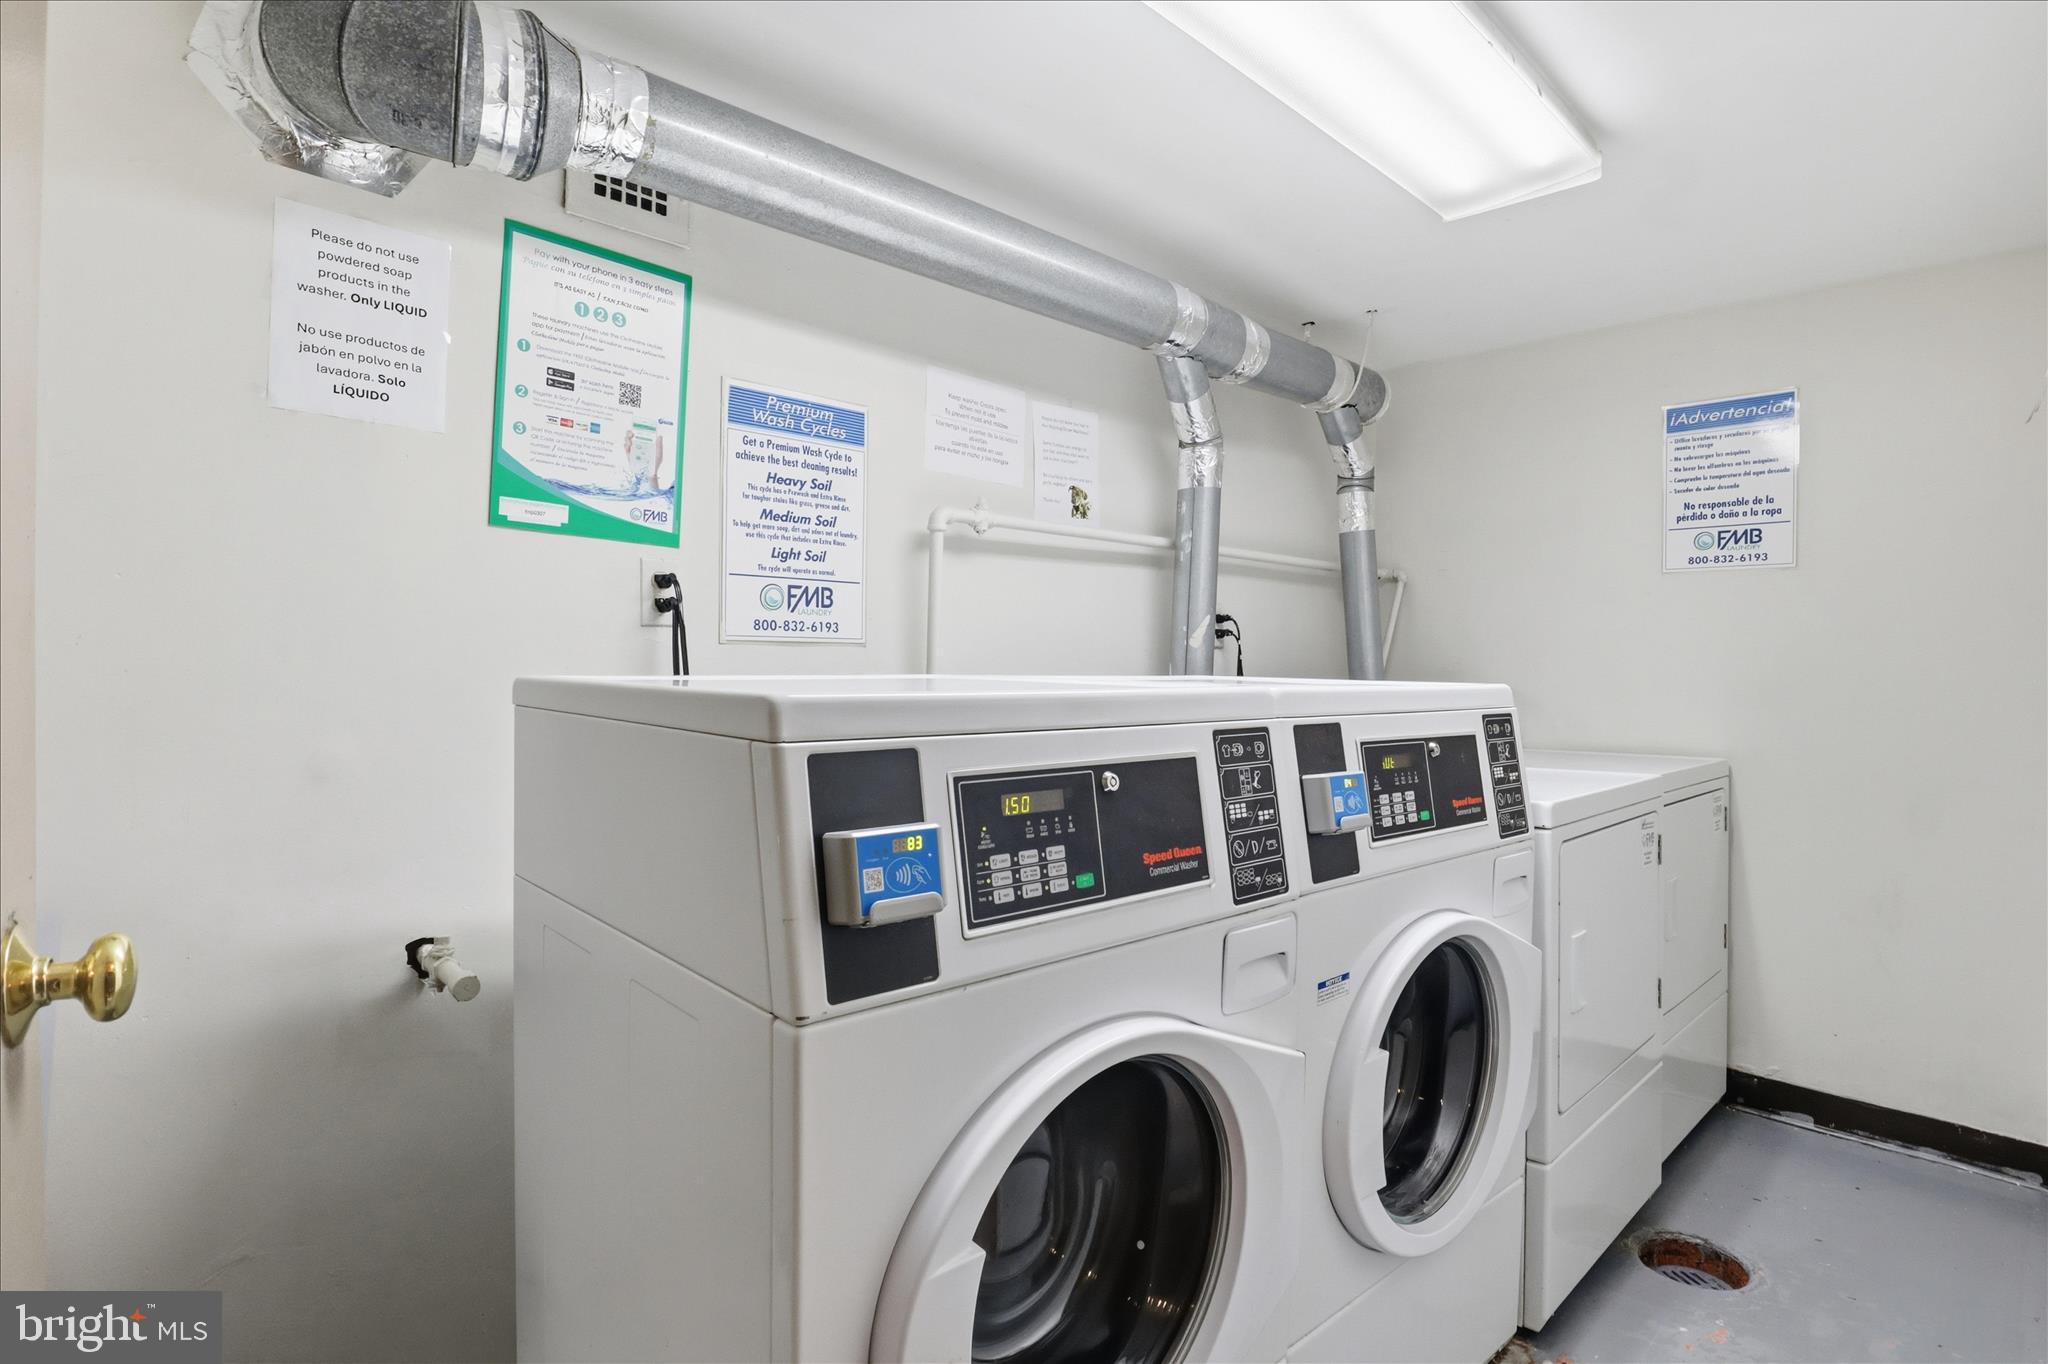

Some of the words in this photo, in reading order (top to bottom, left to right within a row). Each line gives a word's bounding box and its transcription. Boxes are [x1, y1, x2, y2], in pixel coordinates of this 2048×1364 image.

[312, 228, 353, 247] Please
[357, 241, 372, 252] do
[376, 247, 394, 258] not
[398, 252, 419, 264] use
[318, 250, 380, 272] powdered
[384, 265, 412, 280] soap
[534, 248, 551, 259] Pay
[553, 254, 570, 265] with
[572, 259, 589, 272] your
[592, 265, 618, 279] phone
[620, 273, 626, 281] in
[635, 279, 652, 290] easy
[655, 283, 674, 296] steps
[551, 265, 565, 273] con
[318, 269, 374, 289] products
[378, 281, 388, 291] in
[392, 285, 410, 296] the
[573, 286, 585, 295] EASY
[297, 282, 346, 301] washer.
[351, 293, 380, 309] Only
[384, 300, 427, 318] LIQUID
[297, 323, 315, 334] No
[319, 329, 342, 339] use
[346, 333, 408, 353] productos
[411, 346, 425, 356] de
[299, 342, 335, 356] jabón
[339, 350, 354, 360] en
[358, 353, 391, 367] polvo
[394, 360, 409, 370] en
[412, 363, 422, 373] la
[317, 363, 374, 382] lavadora.
[378, 374, 406, 387] Solo
[333, 384, 390, 401] LÍQUIDO
[766, 396, 834, 421] Premium
[752, 408, 794, 428] Wash
[801, 418, 847, 439] Cycles
[743, 435, 756, 446] Get
[767, 439, 800, 454] Premium
[803, 445, 822, 457] Wash
[825, 450, 842, 462] Cycle
[845, 454, 852, 462] to
[736, 450, 765, 463] achieve
[768, 454, 780, 464] the
[782, 456, 798, 468] best
[801, 460, 829, 475] cleaning
[832, 467, 858, 477] results!
[748, 483, 758, 491] This
[766, 472, 806, 490] Heavy
[810, 478, 832, 491] Soil
[1684, 502, 1695, 512] No
[1698, 498, 1749, 511] responsable
[1752, 496, 1762, 506] de
[1766, 495, 1774, 505] la
[1719, 509, 1738, 519] daño
[1751, 508, 1759, 517] la
[1761, 507, 1782, 518] ropa
[643, 509, 668, 523] FMB
[740, 521, 751, 529] help
[760, 508, 811, 525] Medium
[815, 515, 837, 528] Soil
[1718, 528, 1762, 550] FMB
[771, 547, 801, 562] Light
[804, 550, 826, 562] Soil
[1688, 552, 1768, 565] 800-832-6193
[787, 585, 833, 613] FMB
[754, 619, 839, 633] 800-832-6193
[907, 835, 923, 851] 83
[1142, 848, 1172, 865] Speed
[1174, 846, 1202, 859] Queen
[1150, 864, 1179, 877] Commercial
[1180, 860, 1199, 870] Washer
